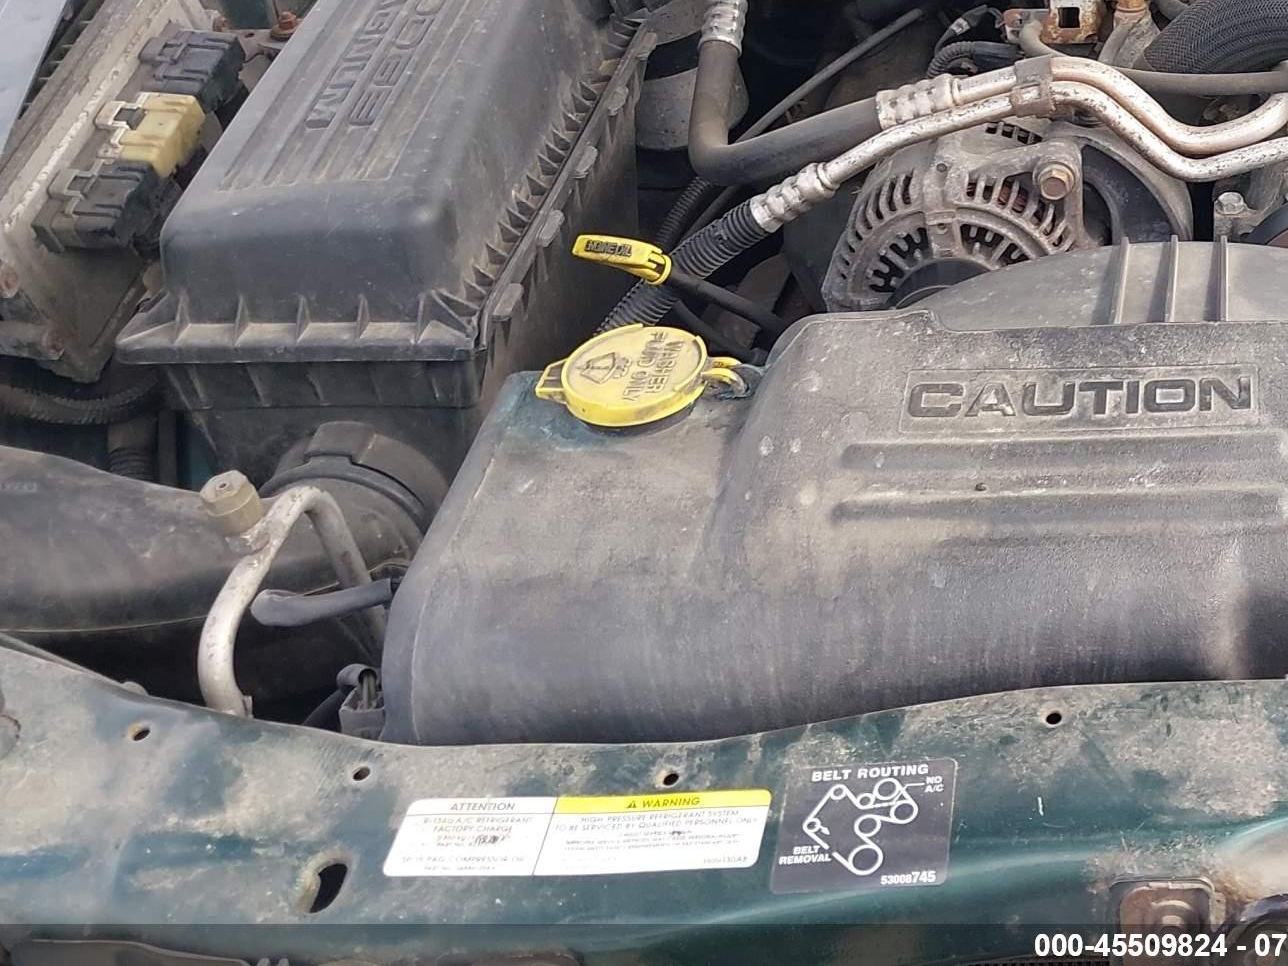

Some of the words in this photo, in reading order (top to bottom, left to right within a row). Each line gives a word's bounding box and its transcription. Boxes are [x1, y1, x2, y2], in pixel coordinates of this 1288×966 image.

[637, 332, 668, 368] FLUID
[645, 340, 684, 393] WASHER
[622, 371, 648, 401] ONLY
[907, 377, 1251, 418] CAUTION
[812, 769, 851, 782] BELT
[857, 764, 929, 779] ROUTING
[926, 776, 942, 784] NO
[925, 784, 944, 793] A/C
[449, 802, 516, 811] ATTENTION
[642, 797, 700, 808] WARNING
[476, 816, 532, 824] REFRIGERANT
[649, 811, 705, 820] REFRIGERANT
[708, 810, 739, 818] SYSTEM
[433, 825, 473, 833] FACTORY
[476, 825, 513, 833] CHARGE
[638, 820, 681, 829] QUALIFIED
[793, 845, 821, 855] BELT
[779, 853, 832, 865] REMOVAL
[881, 871, 937, 885] 53008745
